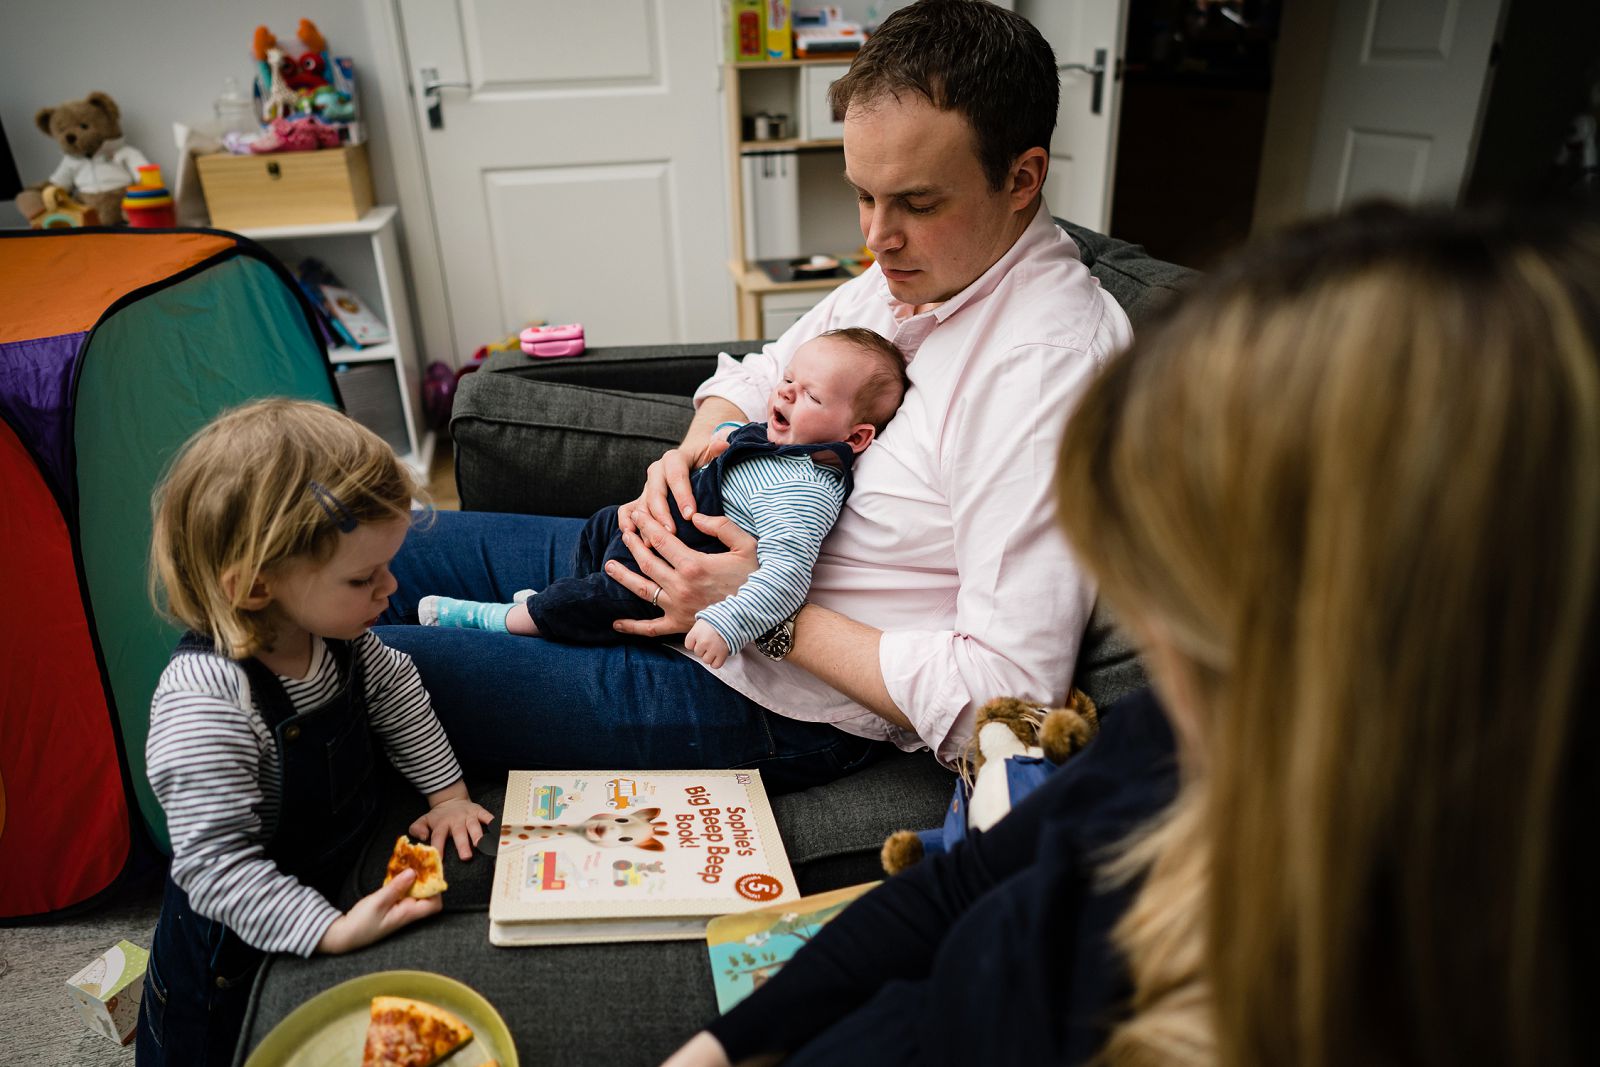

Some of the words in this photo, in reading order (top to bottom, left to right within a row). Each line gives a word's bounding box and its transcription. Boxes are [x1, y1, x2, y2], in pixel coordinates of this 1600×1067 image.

[685, 786, 711, 806] Big
[675, 814, 700, 848] Book!
[699, 808, 724, 842] Beep
[725, 807, 756, 856] Sophie's
[697, 846, 730, 884] Beep
[748, 881, 770, 893] 5
